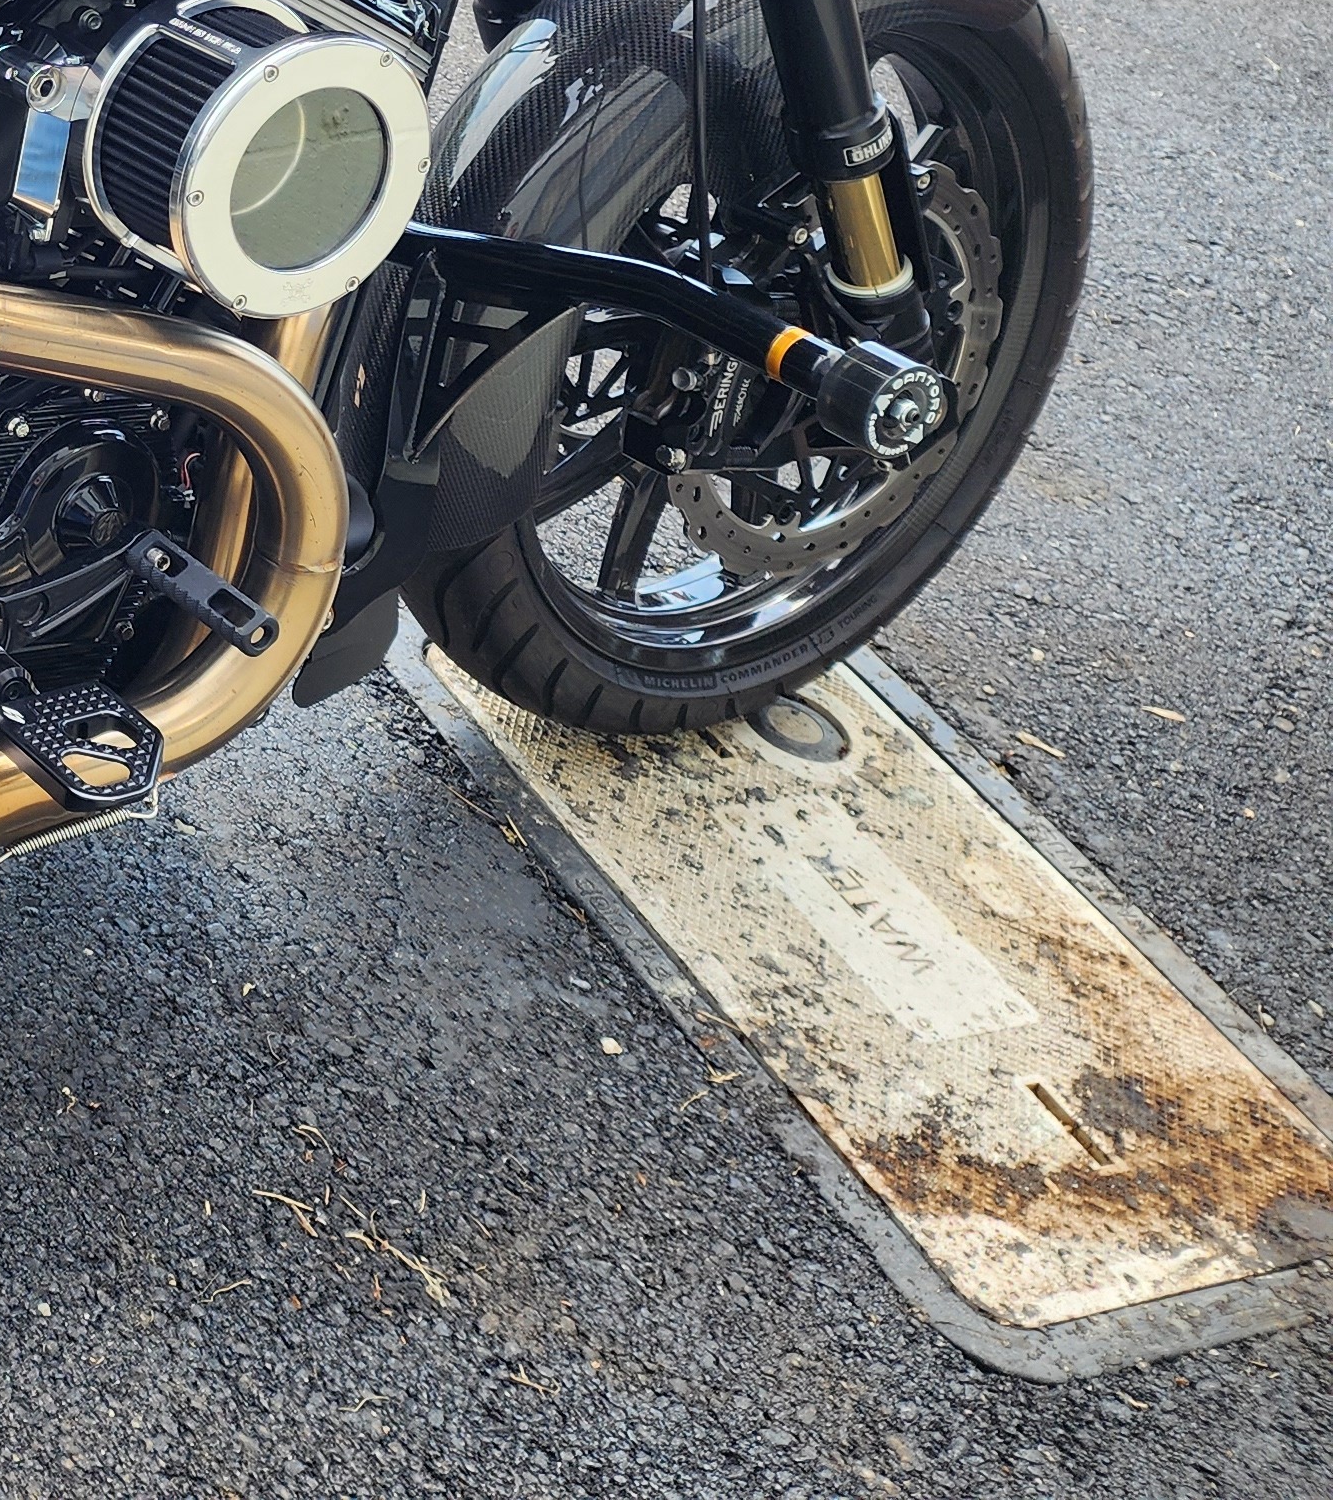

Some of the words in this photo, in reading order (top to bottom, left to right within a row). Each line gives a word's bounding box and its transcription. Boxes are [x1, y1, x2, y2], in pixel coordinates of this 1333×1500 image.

[892, 371, 942, 425] SANTORO
[643, 673, 714, 689] MICHELIN
[719, 643, 809, 684] COMMANDER
